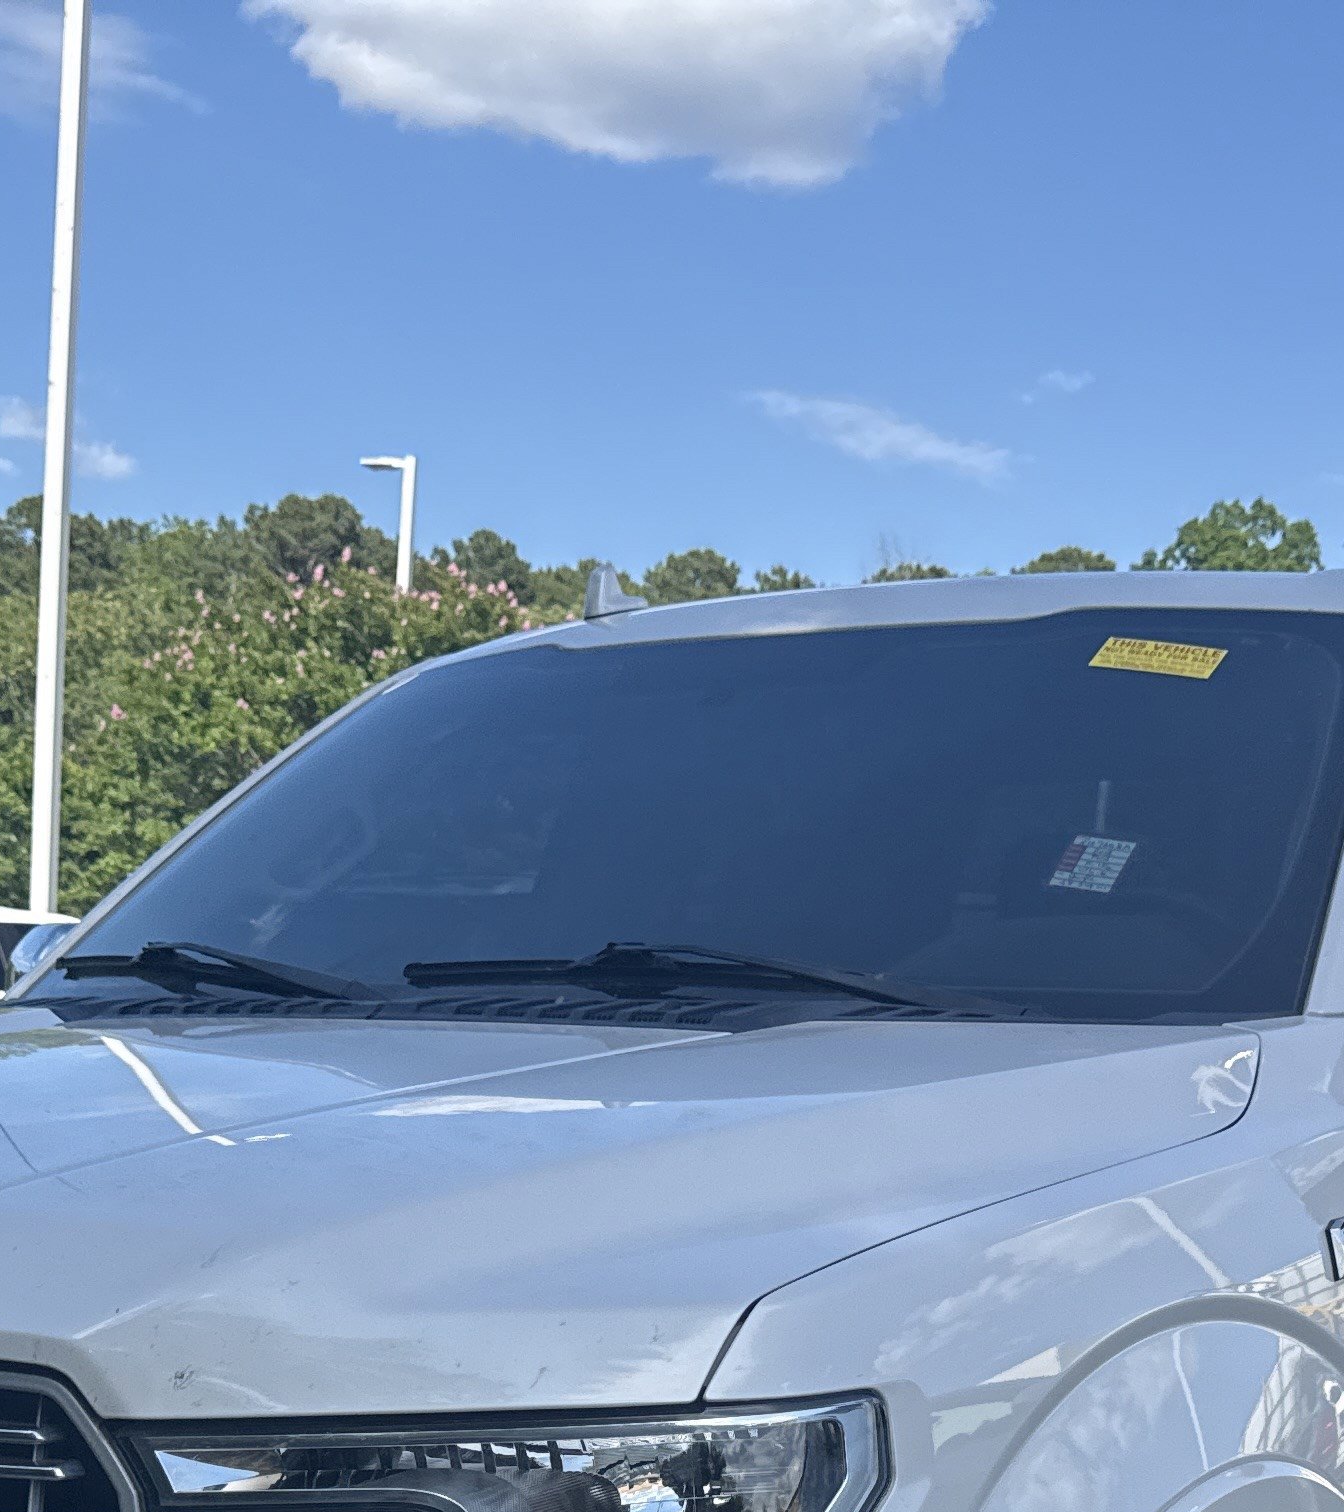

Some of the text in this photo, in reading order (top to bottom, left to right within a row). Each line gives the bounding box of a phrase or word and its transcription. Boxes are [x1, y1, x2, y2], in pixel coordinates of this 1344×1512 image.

[1103, 646, 1124, 654] NOT
[1167, 652, 1189, 661] FOR
[1110, 639, 1222, 657] THIS VEHICLE
